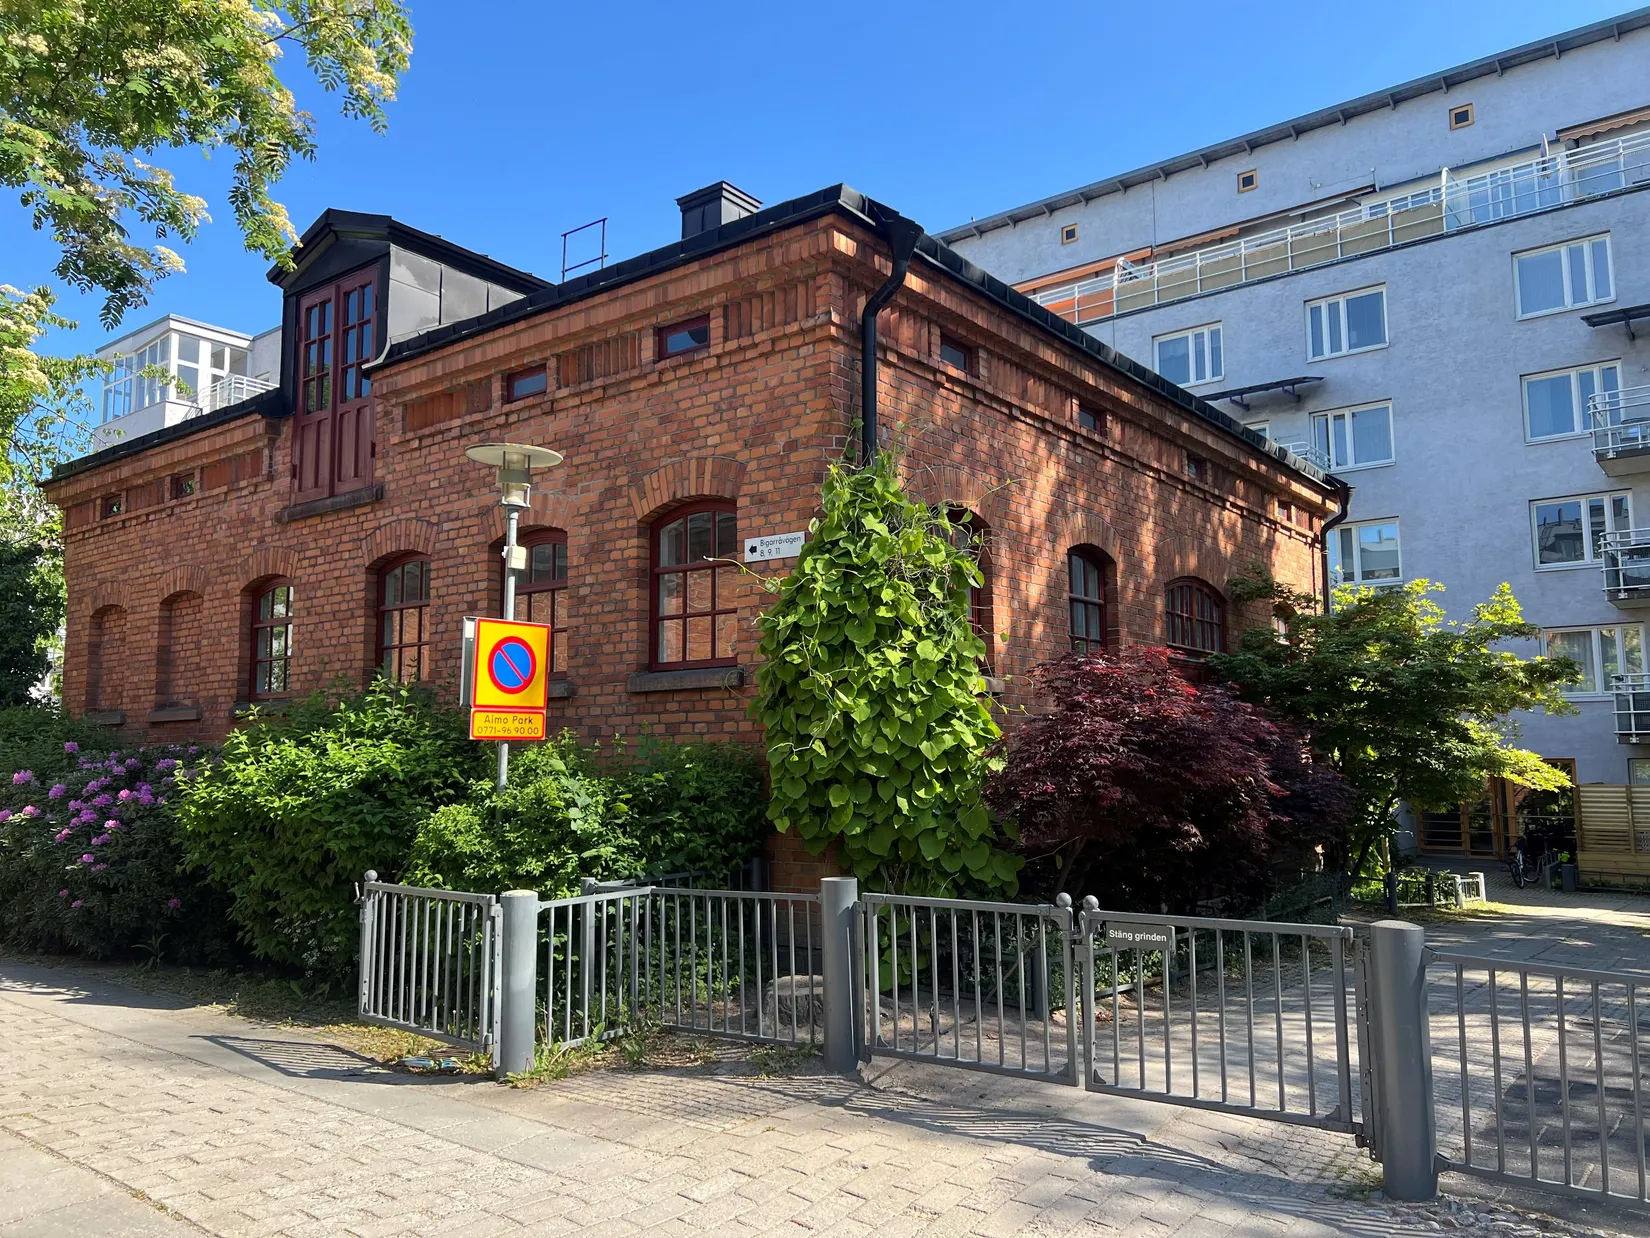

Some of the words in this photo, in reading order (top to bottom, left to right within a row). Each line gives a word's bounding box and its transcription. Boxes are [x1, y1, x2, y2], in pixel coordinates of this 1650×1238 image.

[760, 549, 766, 557] 8,
[768, 548, 773, 556] 9,
[775, 547, 781, 555] 11
[483, 714, 509, 725] Aimo
[512, 715, 534, 725] Park
[477, 726, 512, 735] 0771-96
[514, 726, 526, 735] 90
[527, 726, 540, 735] 00
[1109, 929, 1133, 941] Stäng
[1134, 931, 1167, 942] grinden
